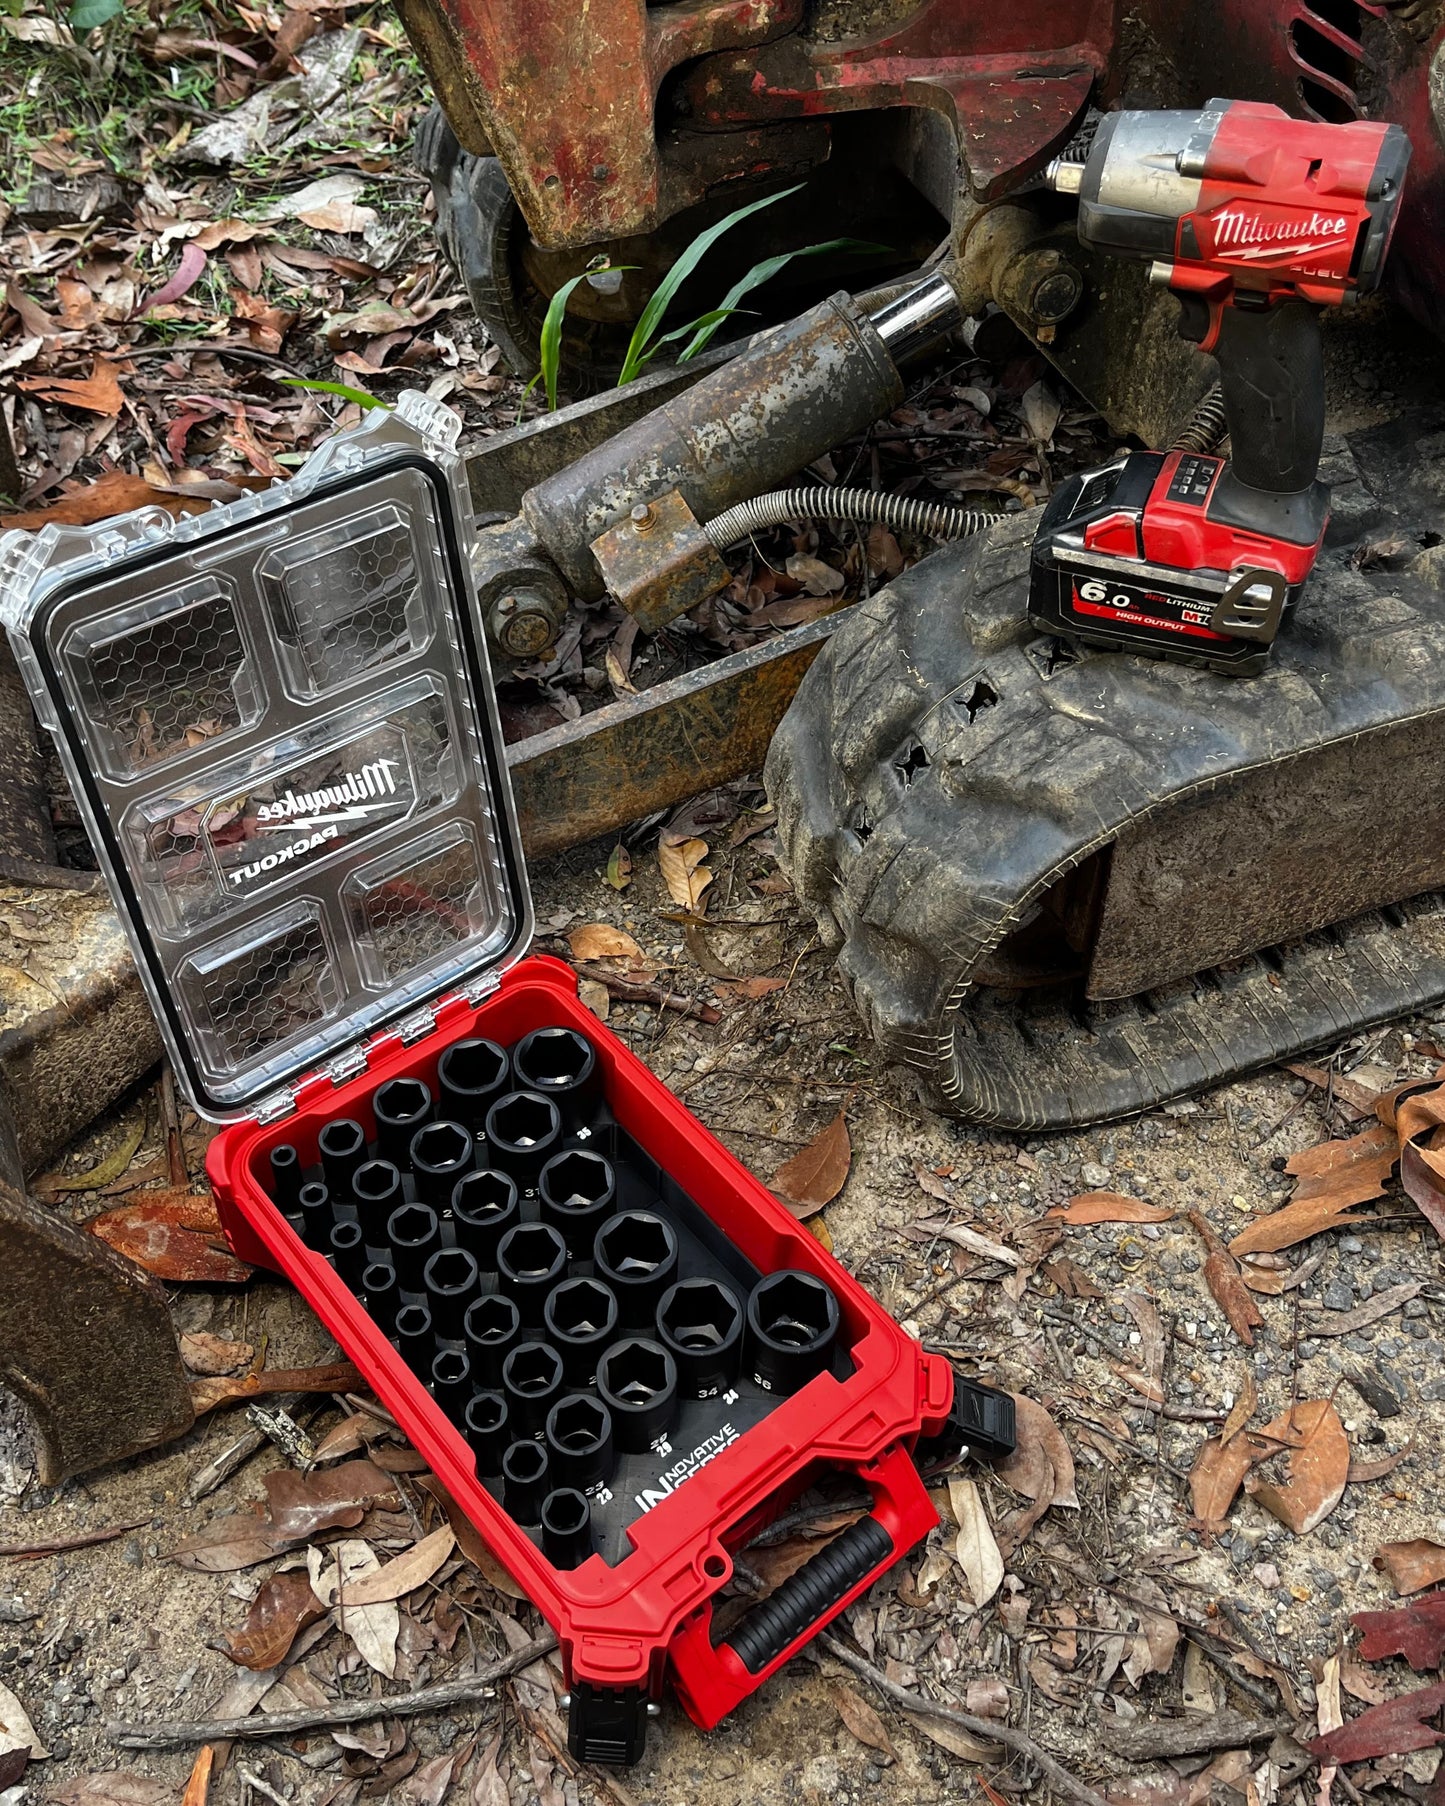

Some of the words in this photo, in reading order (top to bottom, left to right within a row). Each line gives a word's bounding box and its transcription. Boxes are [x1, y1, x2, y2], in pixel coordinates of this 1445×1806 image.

[1211, 209, 1347, 246] Milwaukee
[1289, 265, 1343, 279] FUEL
[1080, 582, 1130, 607] 6.0
[1115, 611, 1143, 623] HIGH
[1144, 617, 1186, 631] OUTPUT
[1183, 611, 1209, 625] M1
[576, 1126, 592, 1140] 35
[754, 1373, 772, 1390] 36
[698, 1386, 718, 1398] 34
[656, 1441, 673, 1458] 29
[596, 1487, 614, 1505] 23
